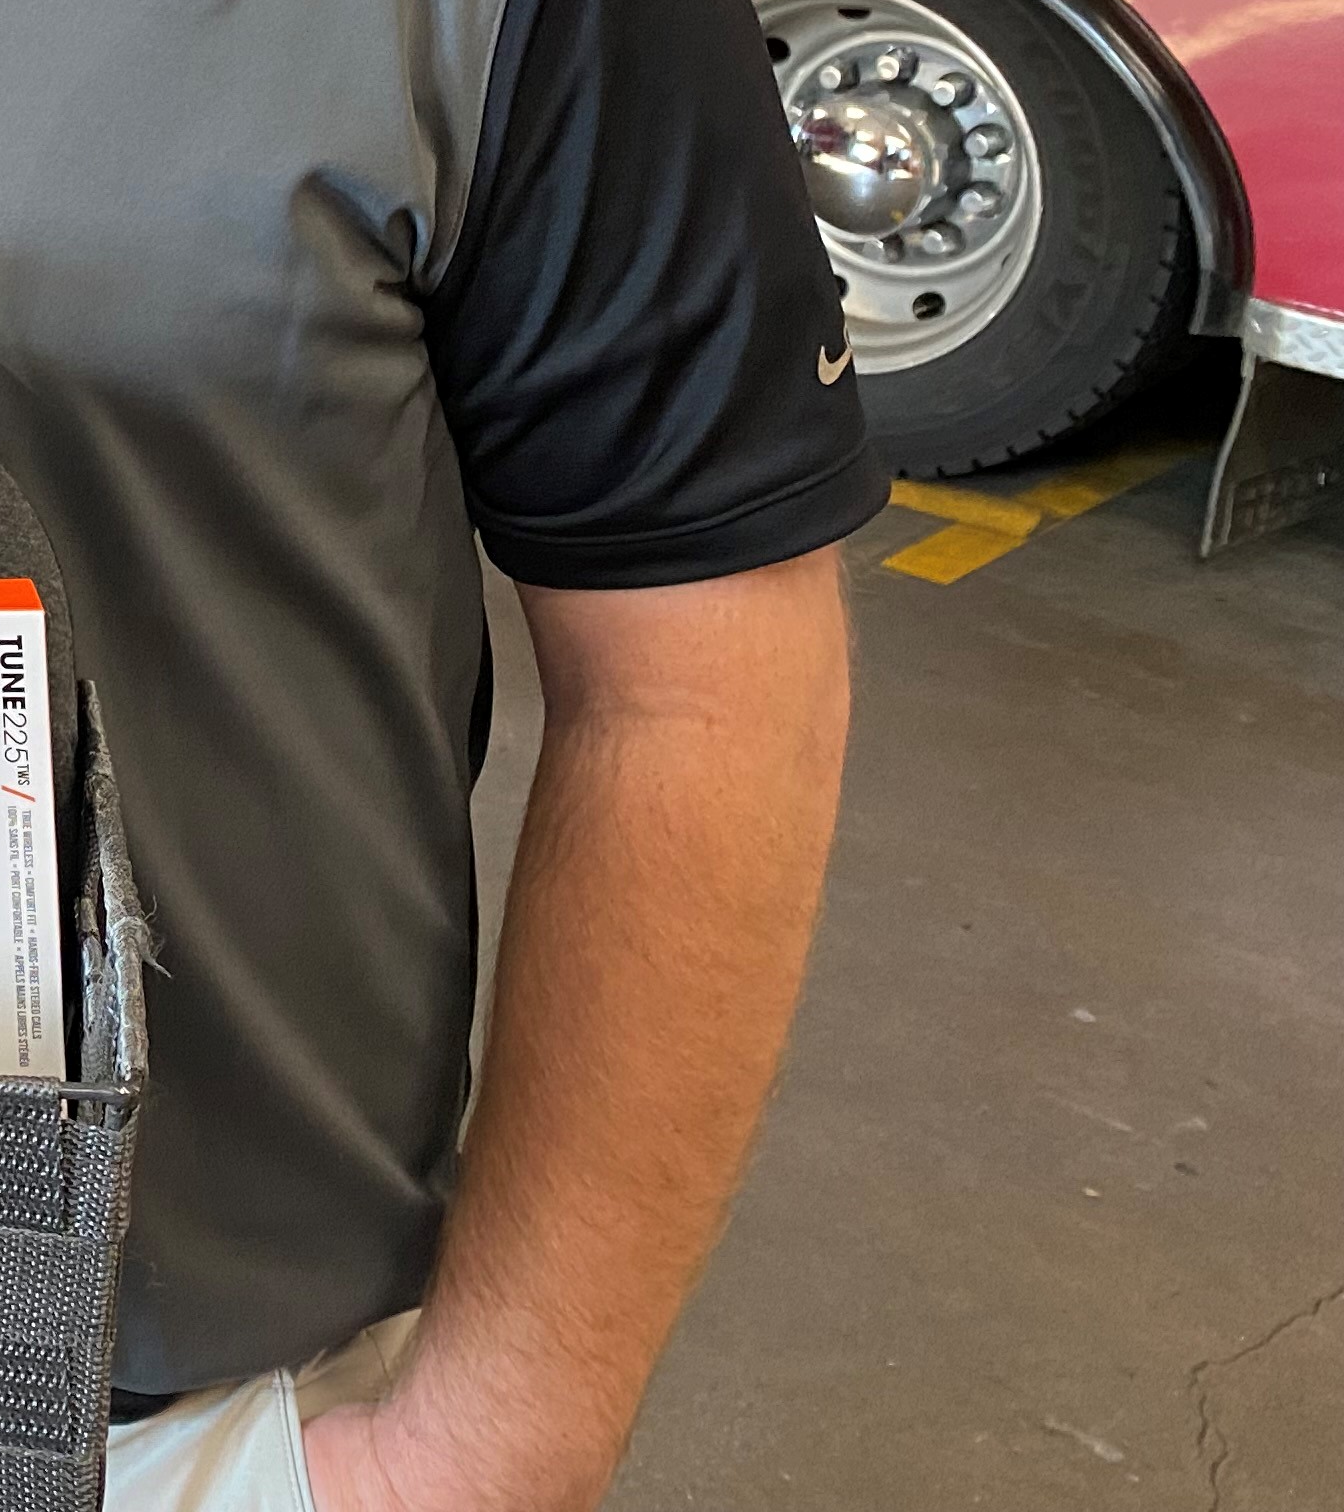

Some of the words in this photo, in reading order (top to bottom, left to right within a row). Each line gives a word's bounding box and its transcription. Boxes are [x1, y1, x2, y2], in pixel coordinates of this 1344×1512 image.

[23, 831, 34, 868] WIRELESS
[25, 877, 37, 912] COMFORT
[29, 986, 41, 1014] STEREO
[31, 1016, 42, 1039] CALLS
